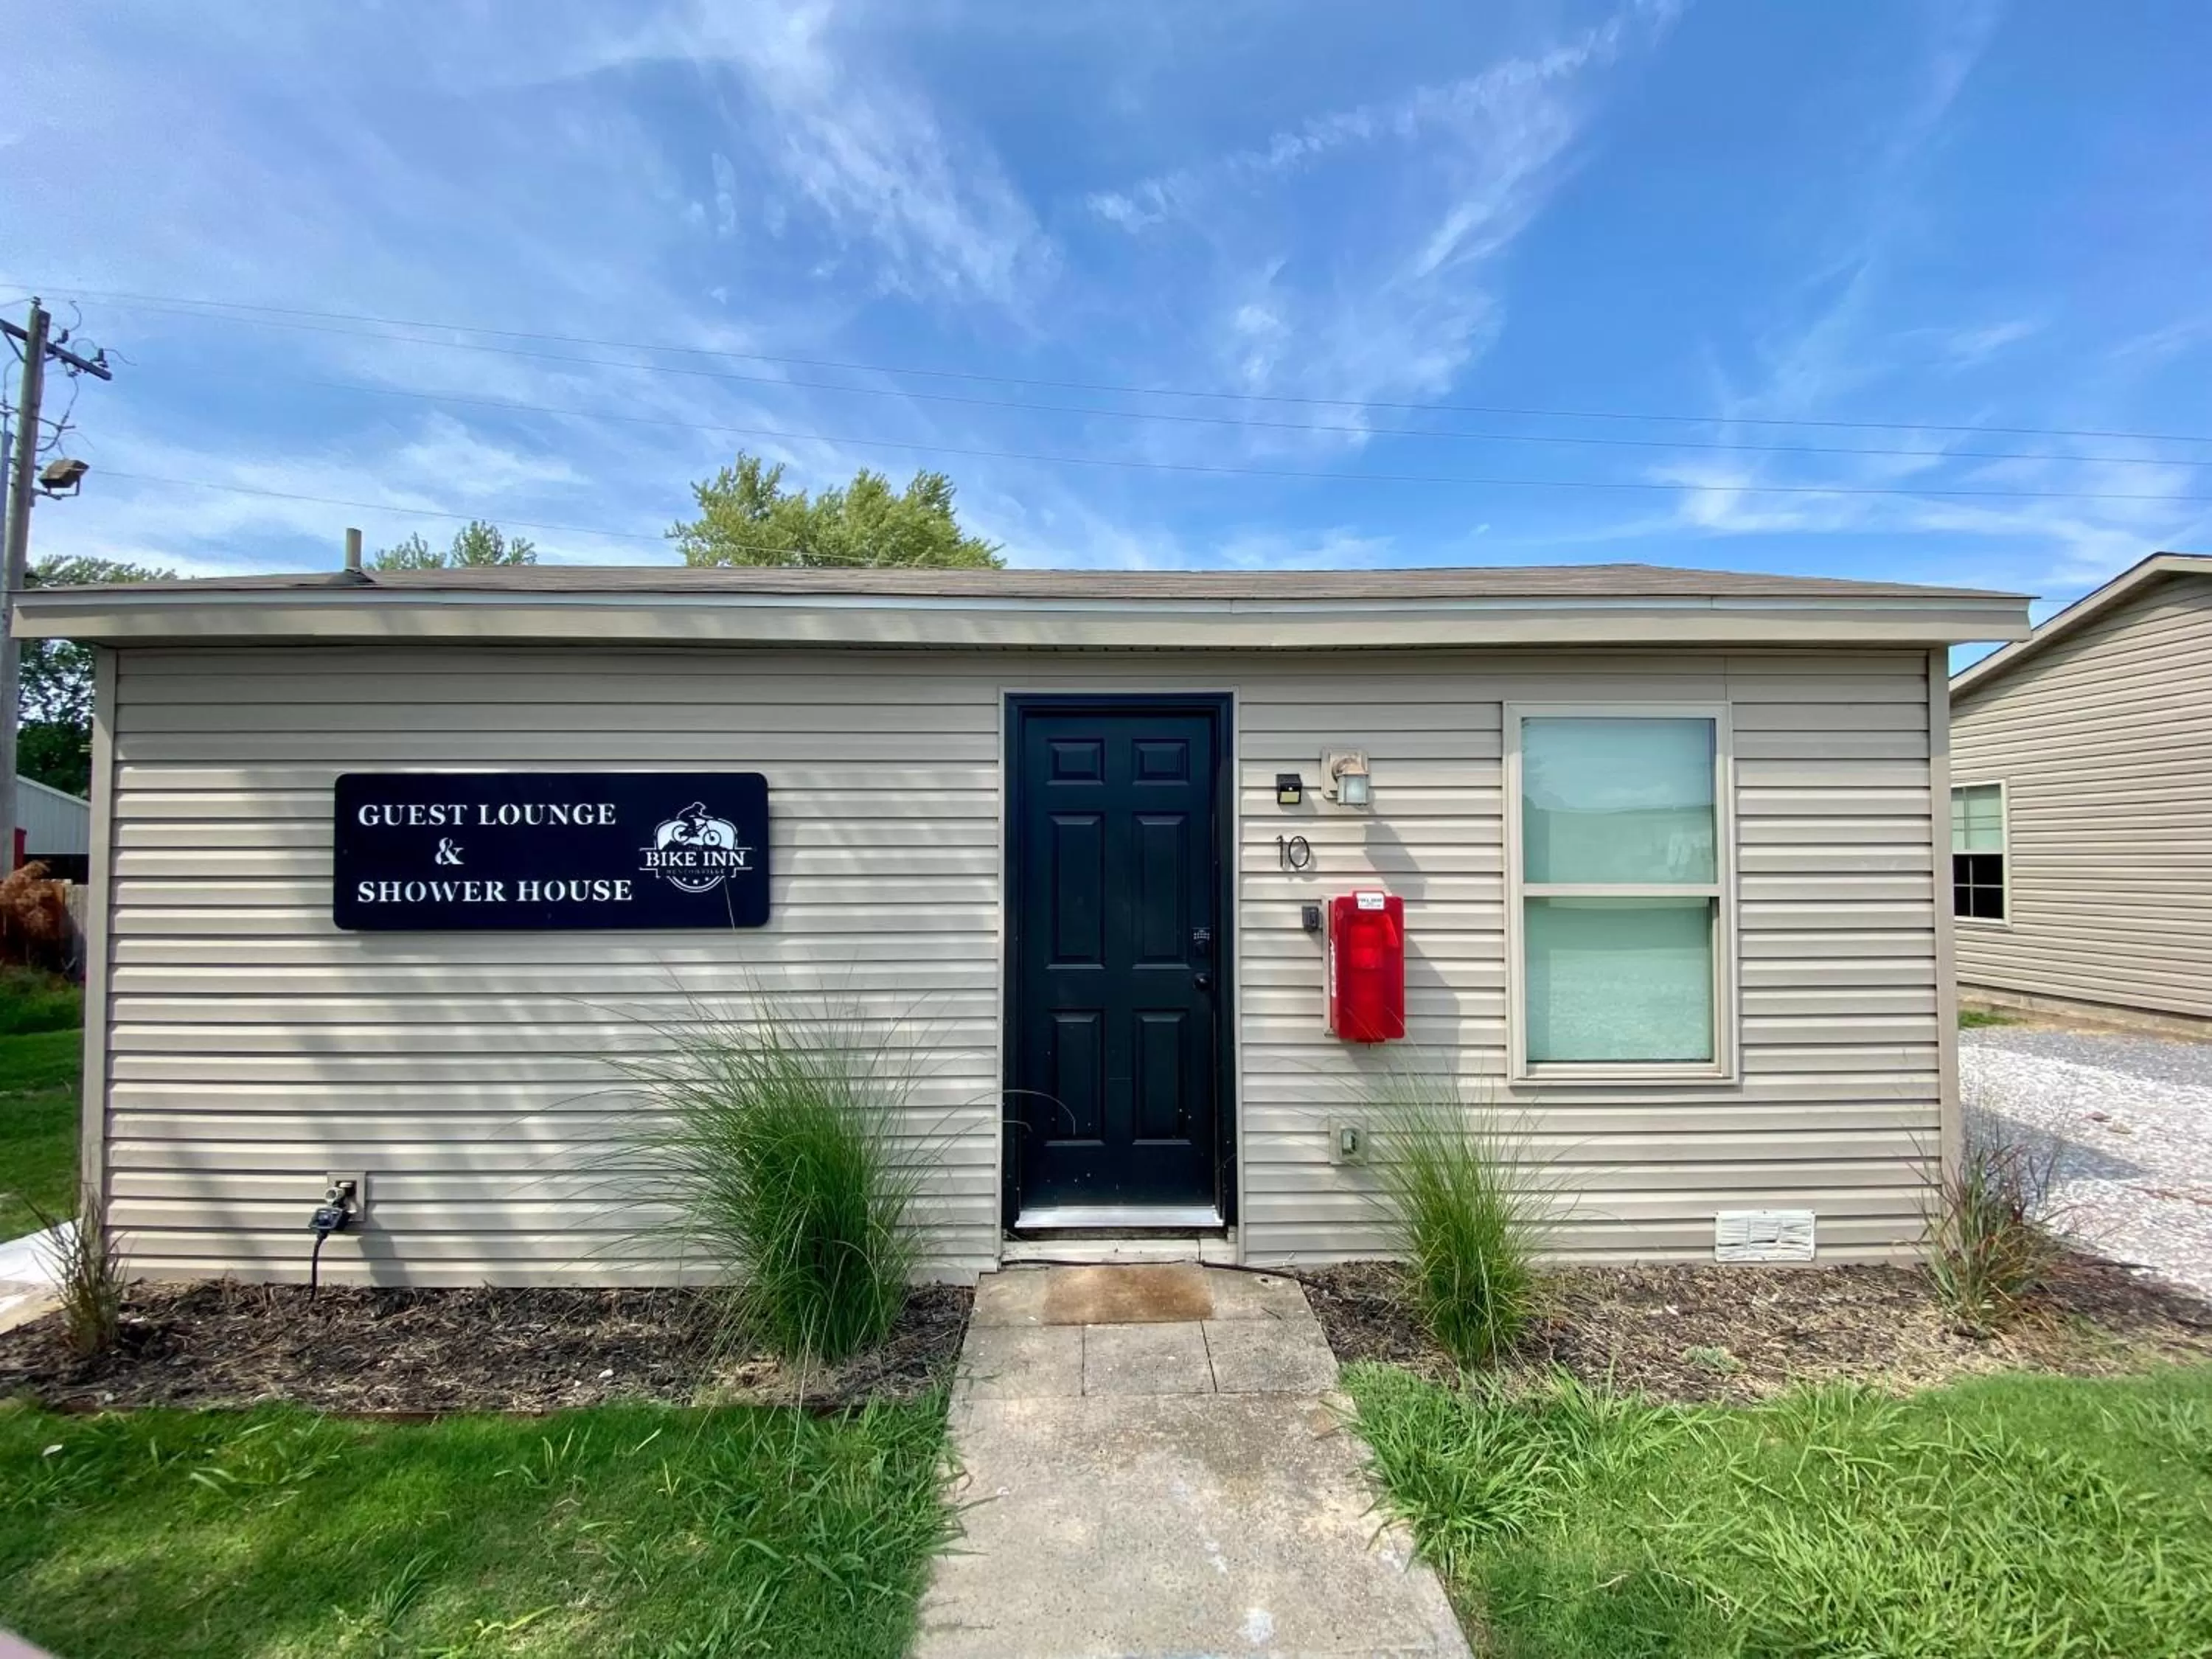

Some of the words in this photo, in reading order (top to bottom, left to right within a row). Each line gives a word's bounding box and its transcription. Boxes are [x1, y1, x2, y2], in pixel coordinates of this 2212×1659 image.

[358, 804, 468, 826] GUEST
[478, 803, 616, 825] LOUNGE
[435, 838, 464, 865] &
[646, 851, 697, 866] BIKE
[703, 851, 745, 866] INN
[1276, 835, 1310, 868] 10
[357, 880, 507, 903] SHOWER
[516, 880, 633, 902] HOUSE
